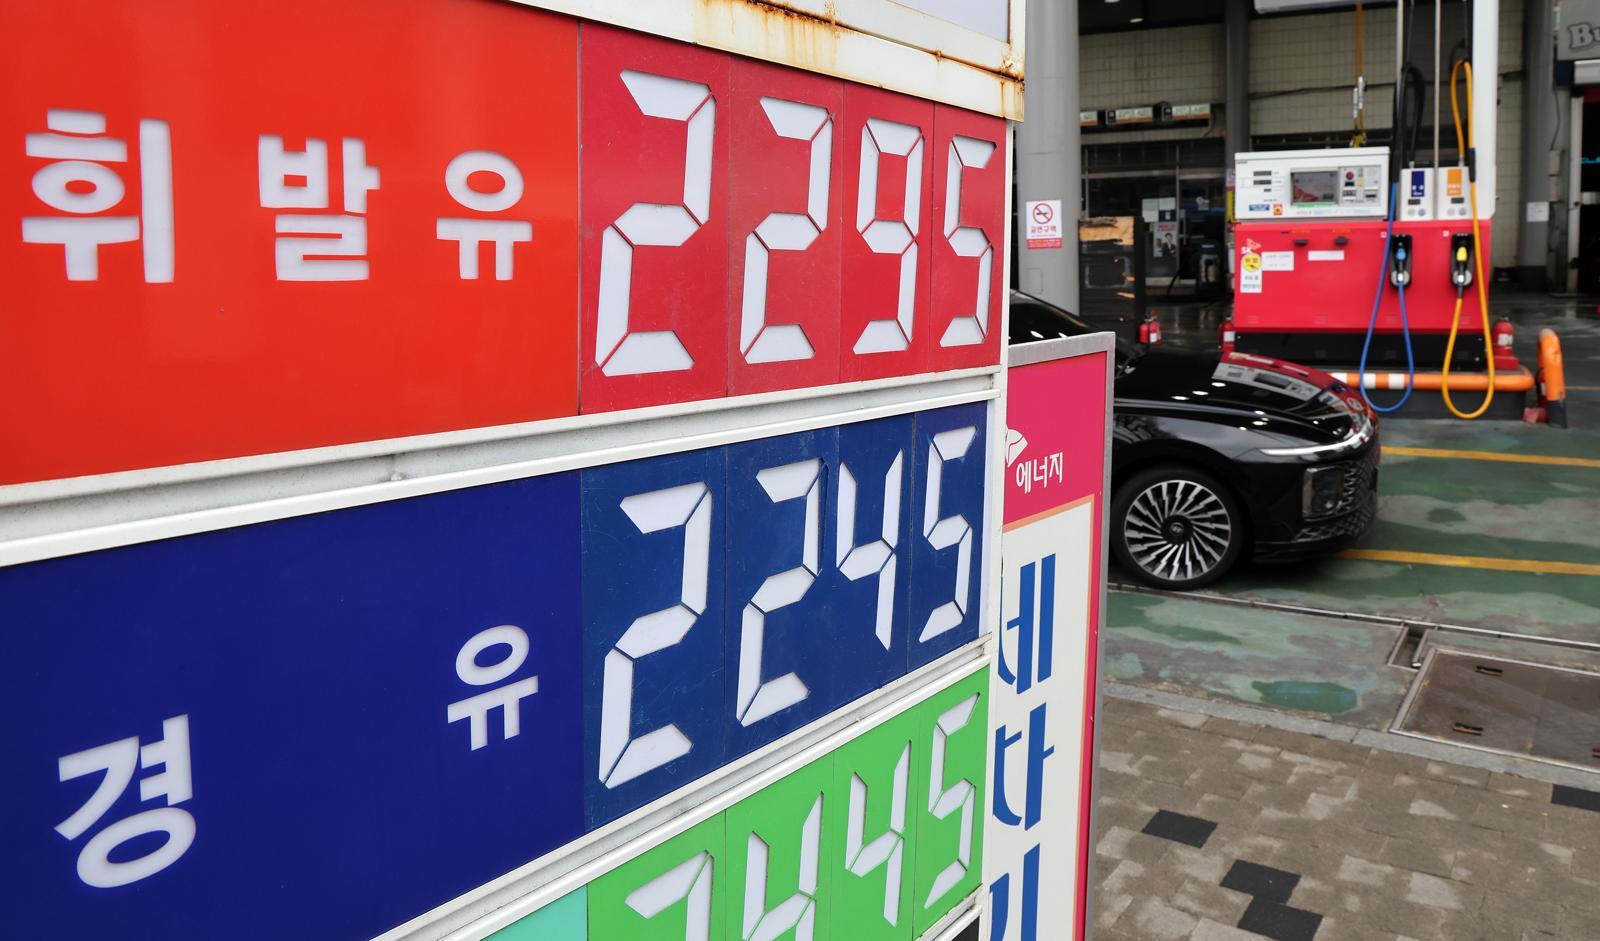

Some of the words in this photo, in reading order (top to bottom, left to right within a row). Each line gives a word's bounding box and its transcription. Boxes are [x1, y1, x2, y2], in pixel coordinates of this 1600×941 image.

[22, 108, 533, 284] 휘발유
[595, 69, 997, 377] 2295
[599, 425, 978, 789] 2245
[1016, 451, 1063, 495] 에너지
